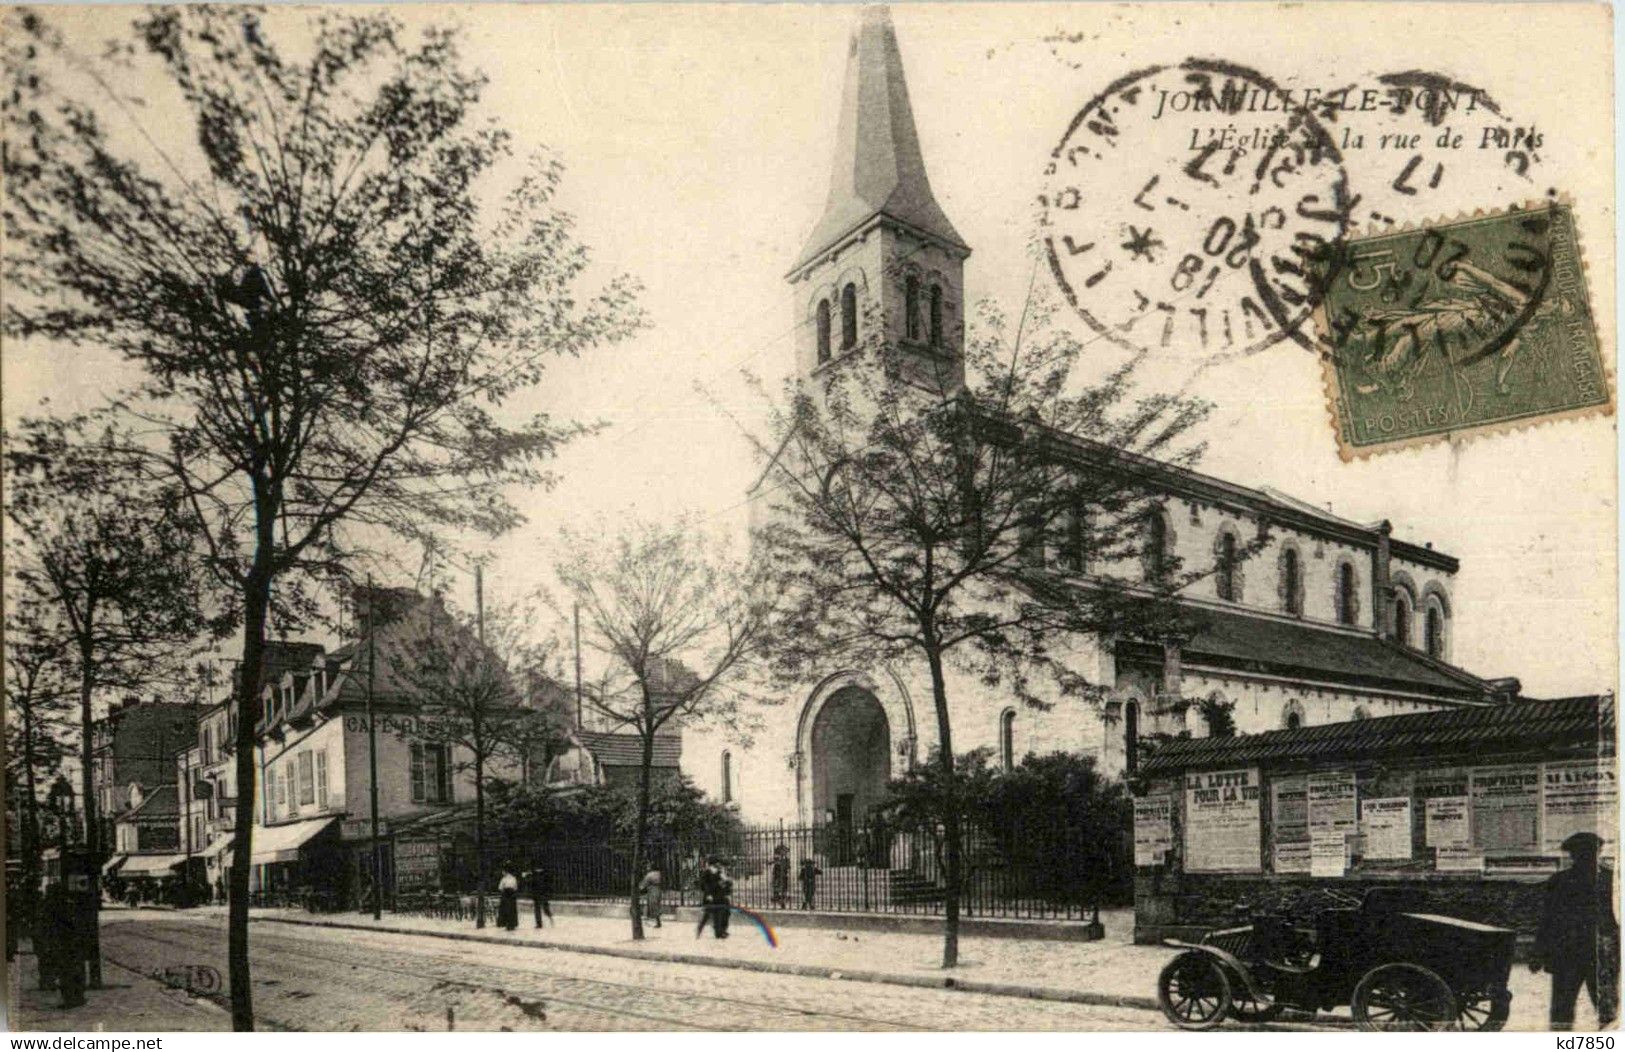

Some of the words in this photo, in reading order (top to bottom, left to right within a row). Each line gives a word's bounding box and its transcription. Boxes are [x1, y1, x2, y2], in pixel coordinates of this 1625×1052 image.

[1364, 404, 1449, 433] POSTES
[1207, 771, 1249, 788] LUTTE
[1223, 787, 1238, 801] LA
